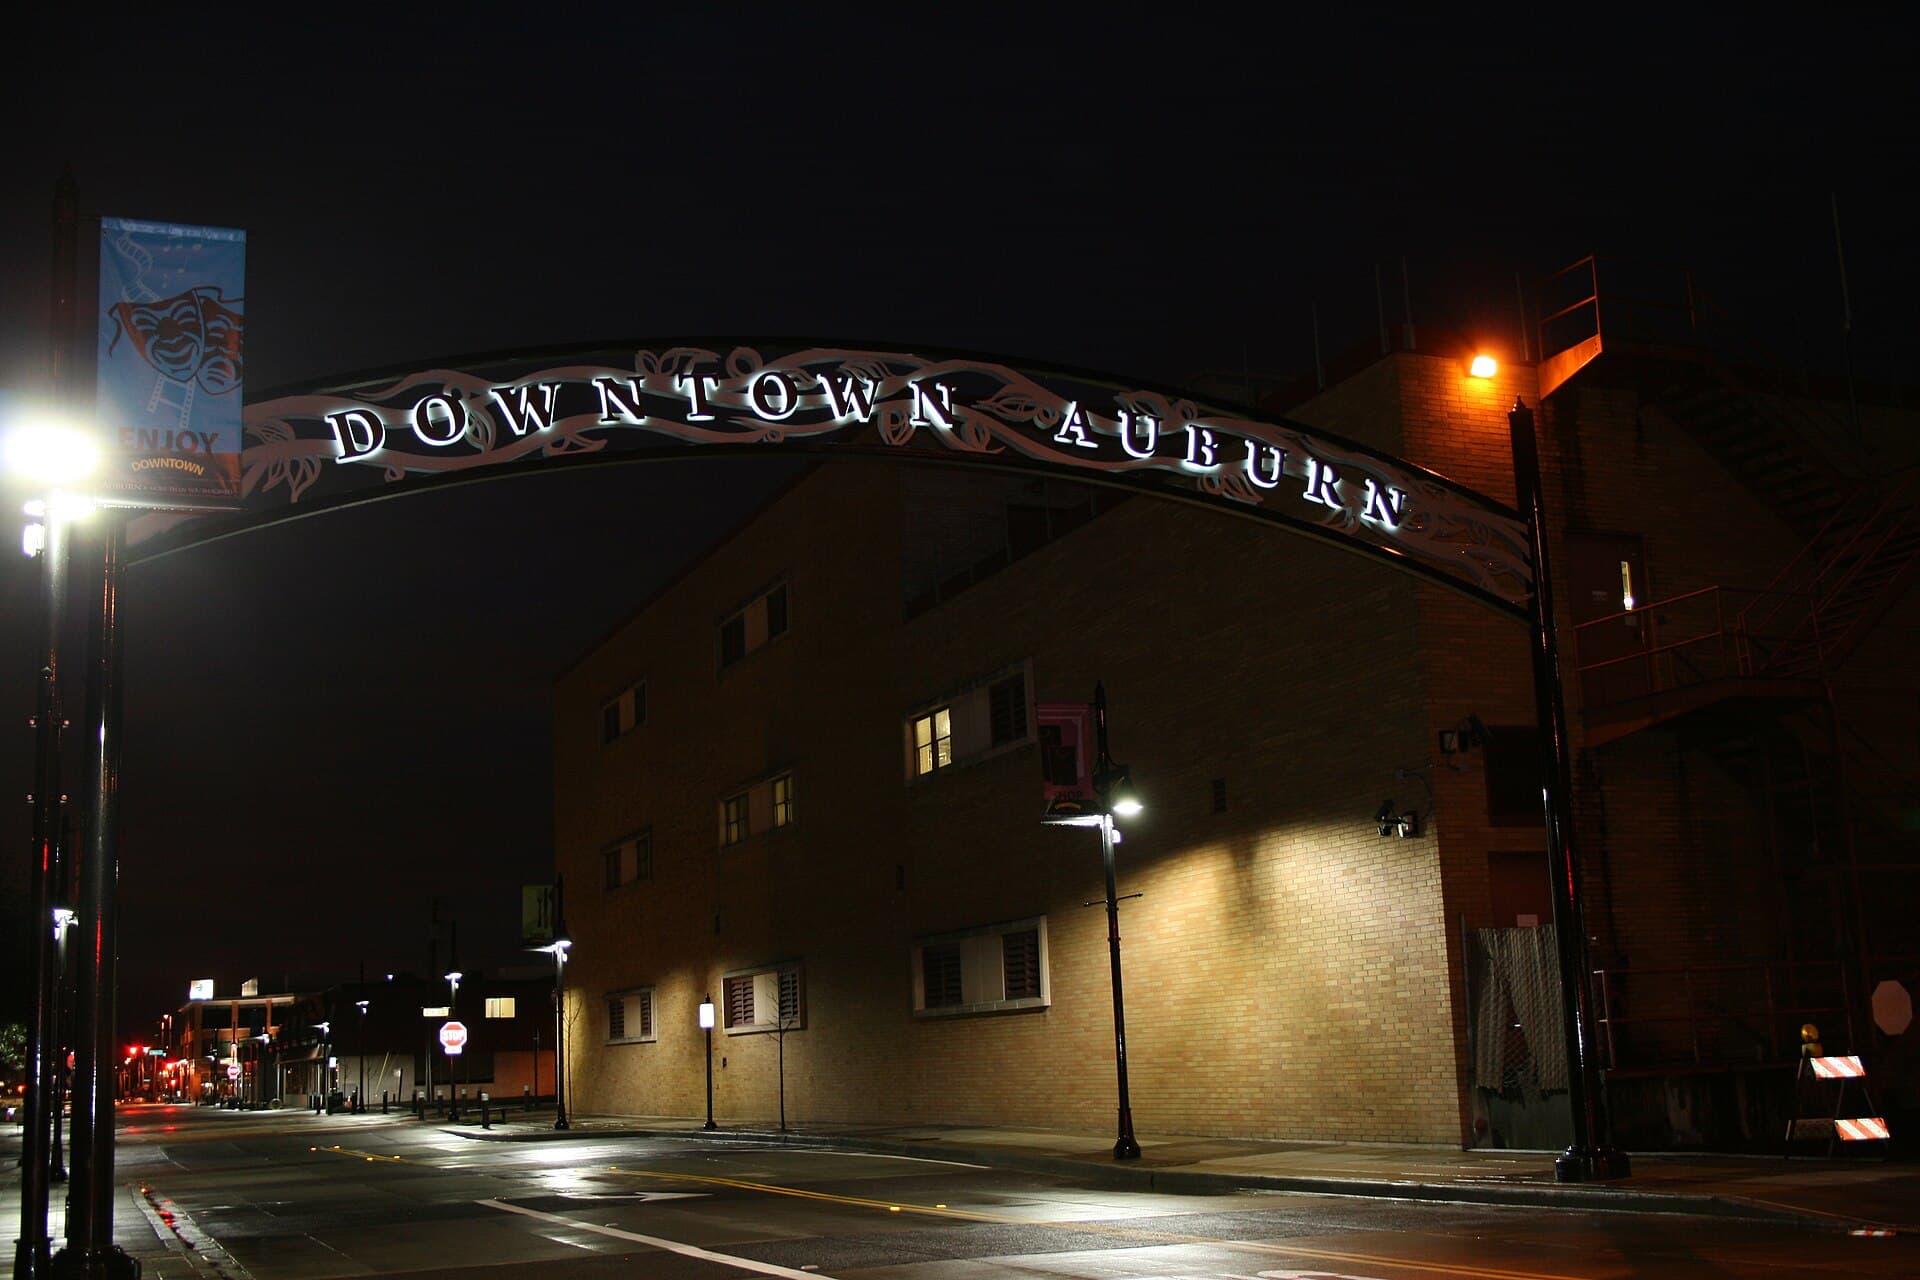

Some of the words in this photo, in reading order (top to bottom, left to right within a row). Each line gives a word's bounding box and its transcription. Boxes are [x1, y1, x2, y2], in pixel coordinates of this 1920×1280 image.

[118, 427, 219, 455] ENJOY
[325, 372, 957, 464] DOWNTOWN
[1053, 400, 1408, 529] AUBURN
[131, 457, 205, 475] DOWNTOWN
[441, 1029, 465, 1041] STOP
